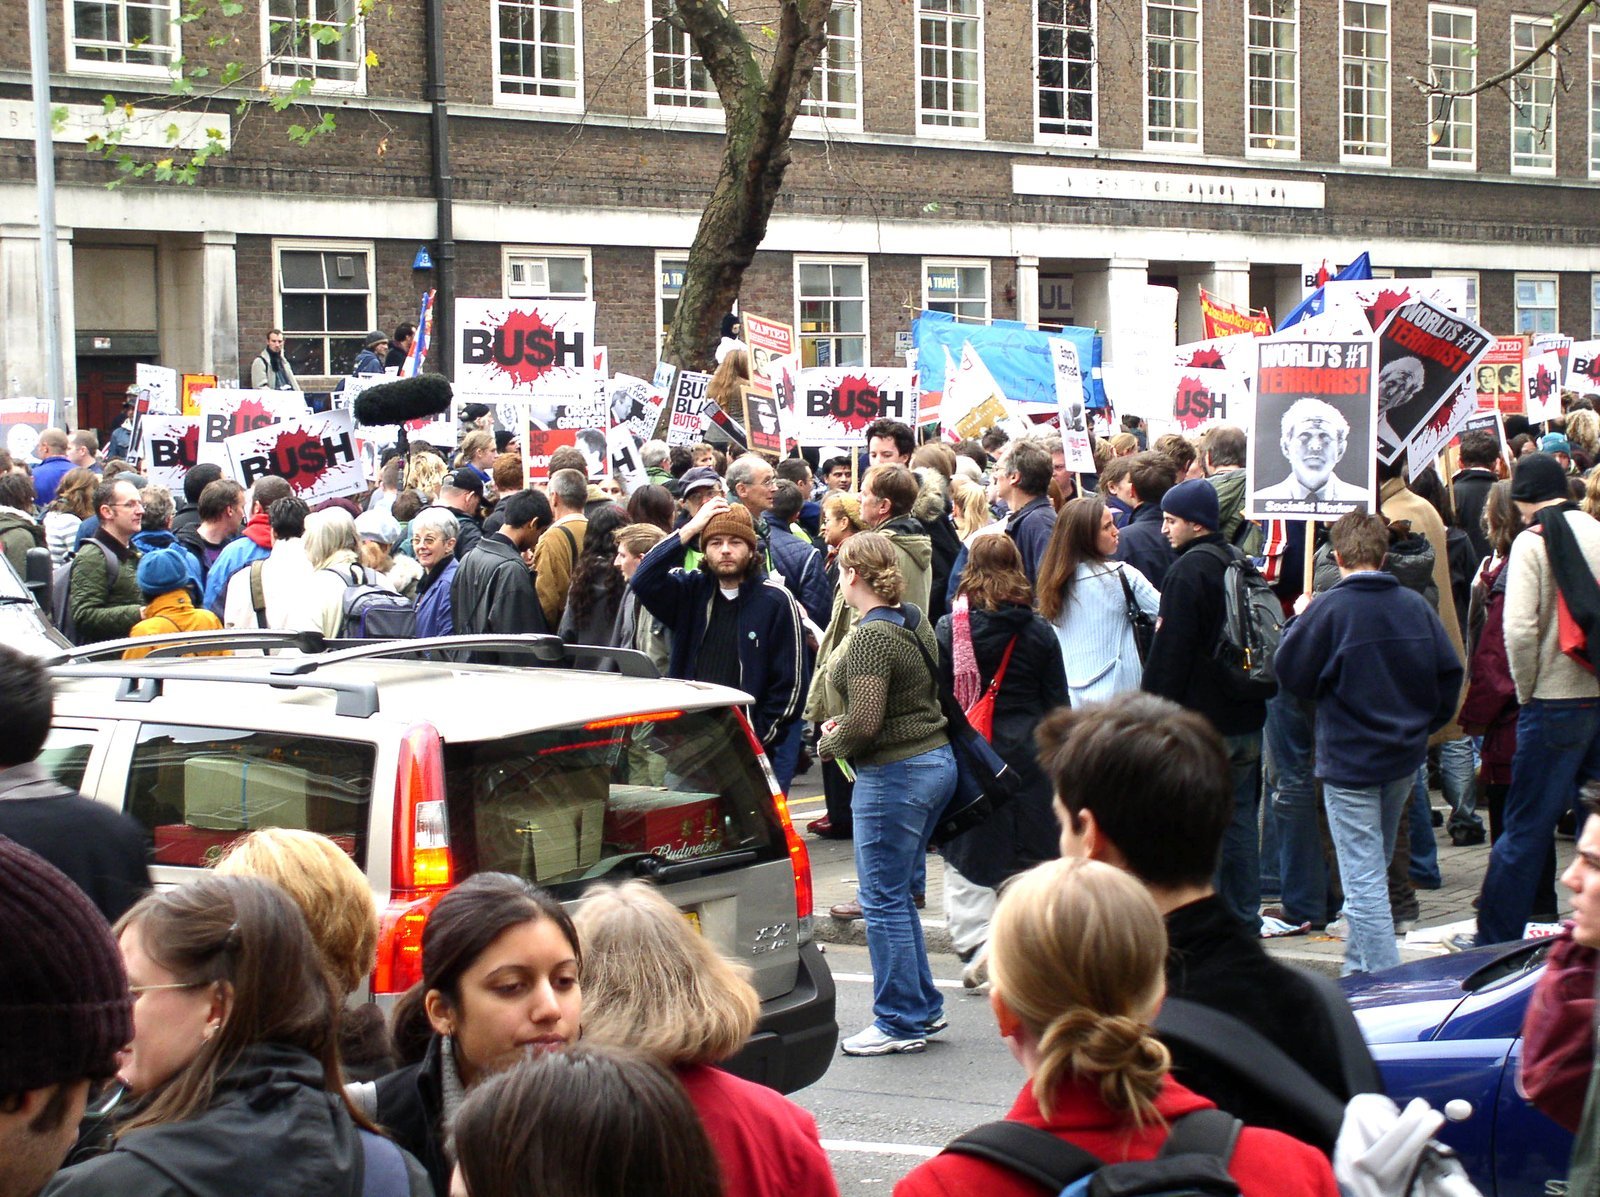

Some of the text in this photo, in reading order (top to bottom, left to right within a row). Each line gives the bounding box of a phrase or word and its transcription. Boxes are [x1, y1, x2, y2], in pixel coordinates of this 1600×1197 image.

[1180, 182, 1235, 197] ONDON
[748, 320, 789, 341] WANTED
[1400, 303, 1483, 354] WORLD'S #1
[1386, 317, 1472, 373] TERRORIST
[1489, 341, 1522, 352] NTED
[1261, 343, 1368, 368] WORLD'S #1
[678, 380, 707, 400] BU
[1259, 367, 1370, 394] TERRORIST
[1174, 390, 1227, 419] USH
[557, 416, 606, 429] GRINDER
[1265, 500, 1316, 513] Socialist
[650, 842, 721, 860] Budweiser
